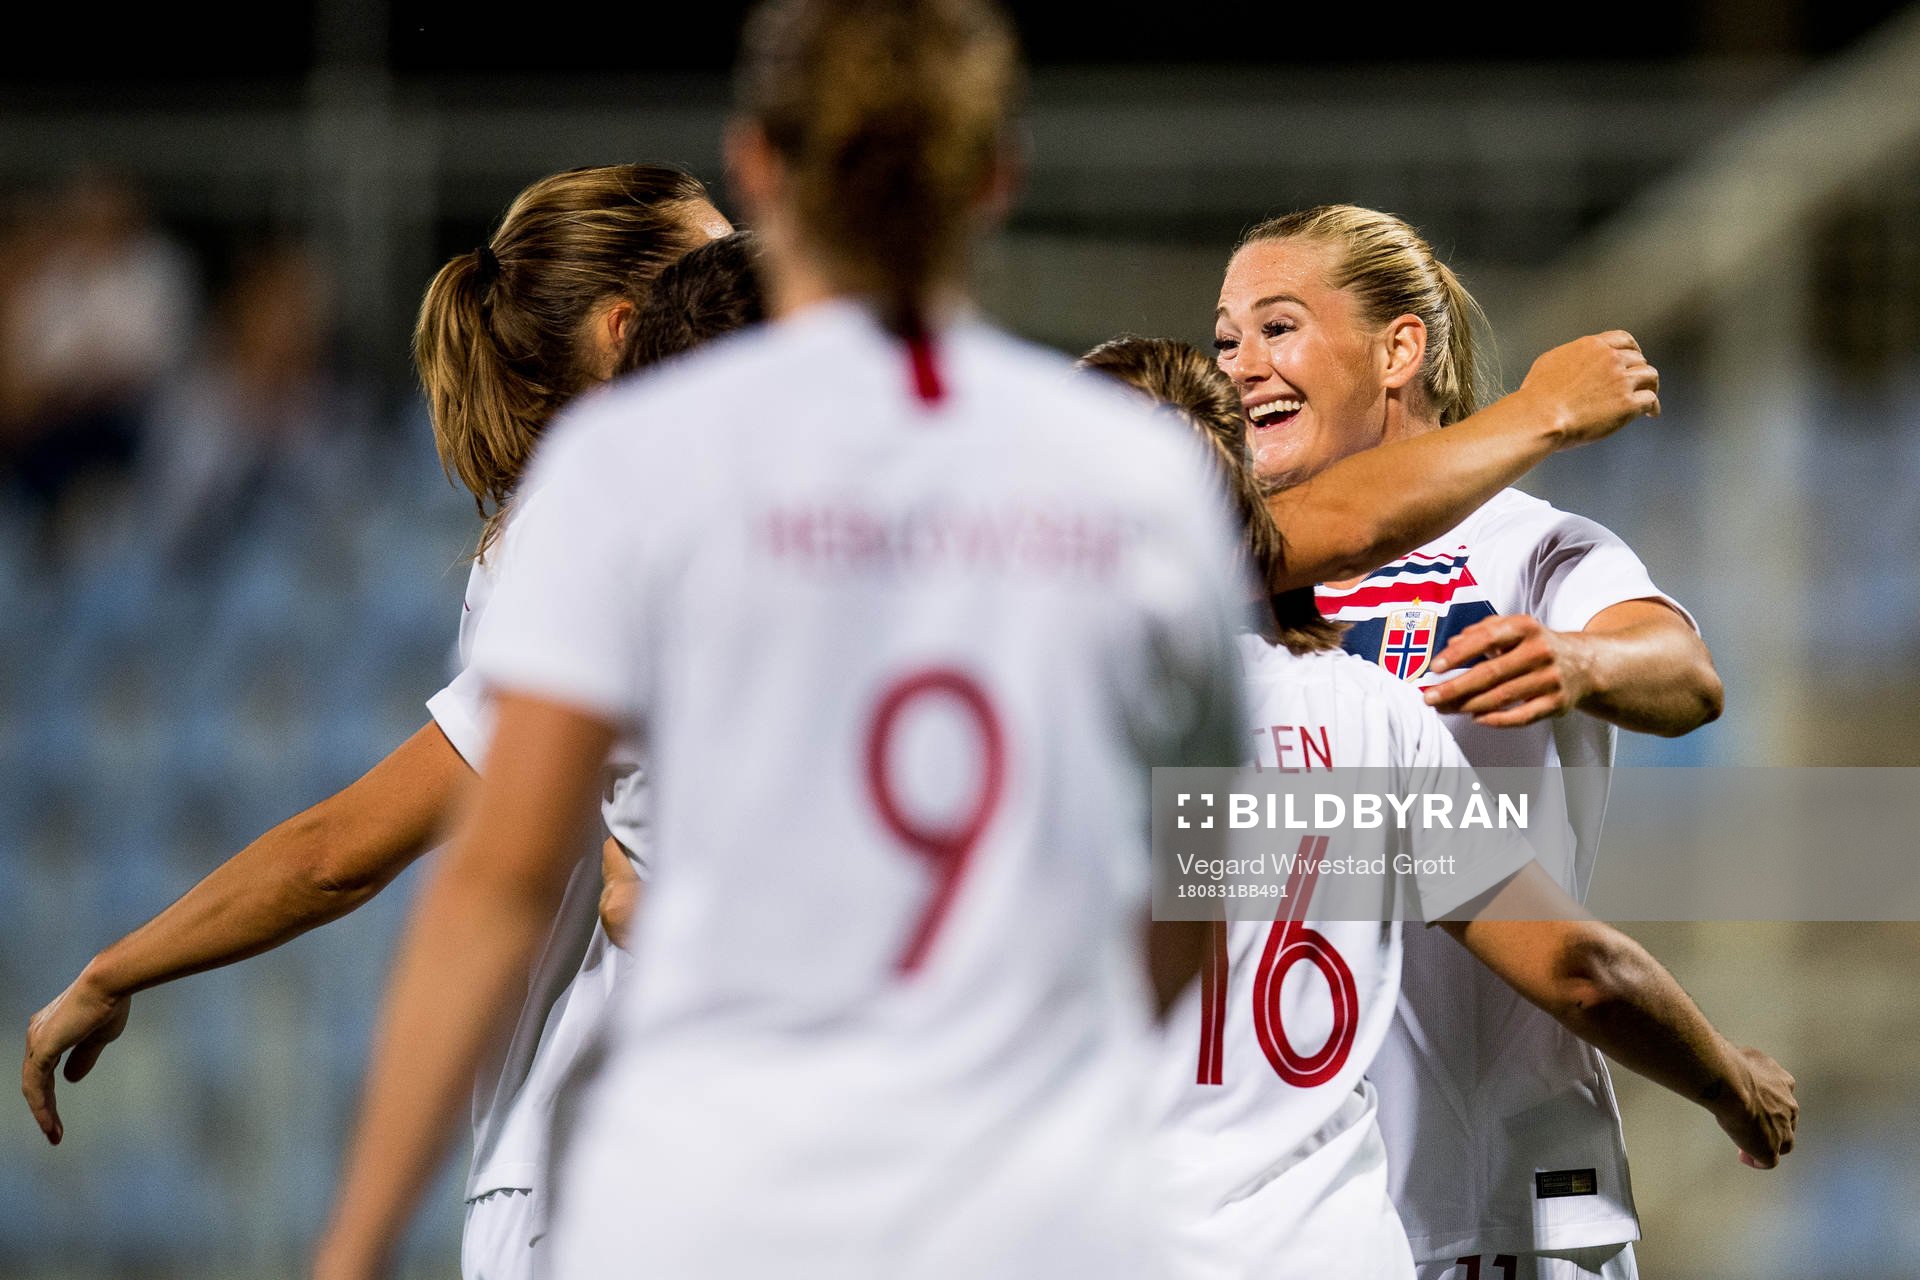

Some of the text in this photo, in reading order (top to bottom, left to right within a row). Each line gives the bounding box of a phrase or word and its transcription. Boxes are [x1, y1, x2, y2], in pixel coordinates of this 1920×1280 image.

[864, 665, 1004, 976] 9
[1249, 726, 1333, 773] TEN
[1196, 835, 1359, 1088] 16
